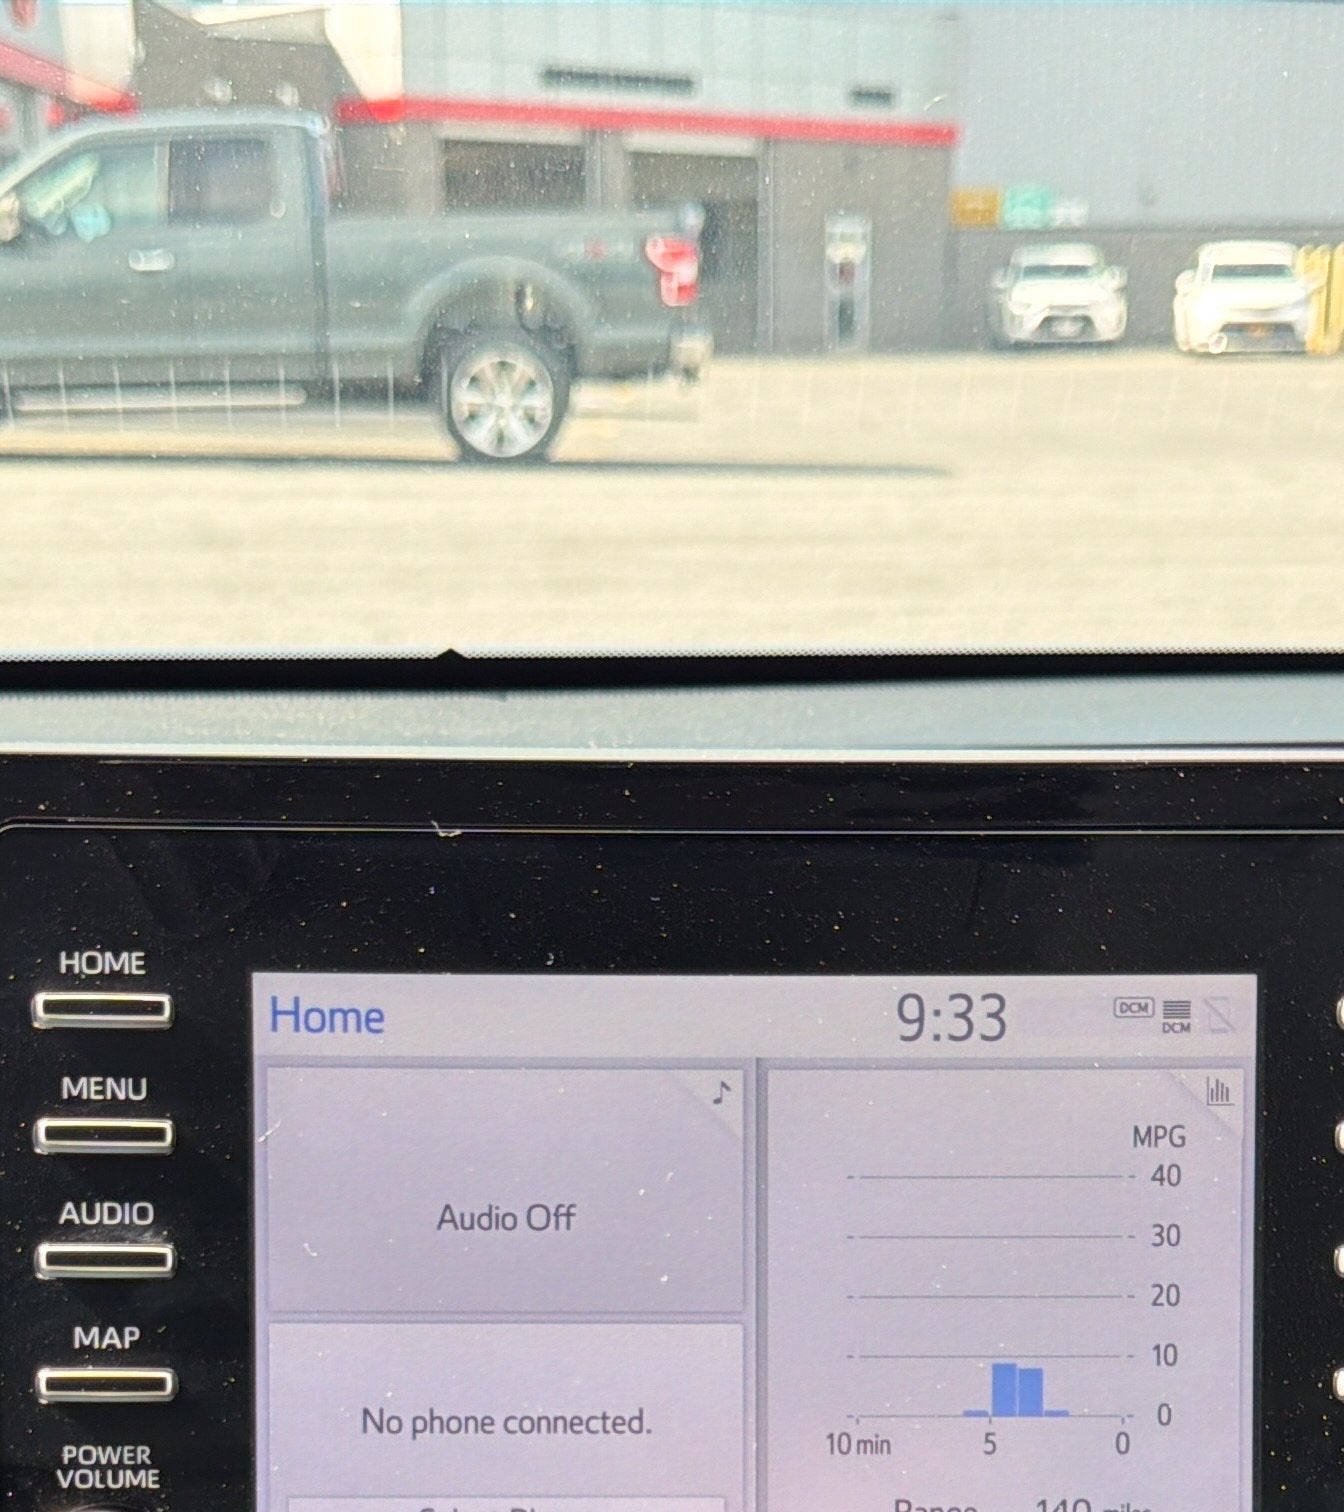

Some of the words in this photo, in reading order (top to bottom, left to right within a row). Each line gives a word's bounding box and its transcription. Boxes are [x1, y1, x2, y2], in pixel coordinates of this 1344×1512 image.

[59, 950, 147, 976] HOME
[269, 995, 386, 1036] Home
[896, 992, 1008, 1043] 9:33
[1119, 1002, 1149, 1014] DCM
[1162, 1022, 1191, 1034] DCM
[61, 1076, 149, 1102] MENU
[1132, 1123, 1187, 1149] MPG
[1149, 1163, 1183, 1188] 40
[58, 1201, 155, 1227] AUDIO
[436, 1201, 519, 1233] Audio
[526, 1202, 578, 1233] Off
[1150, 1223, 1182, 1248] 30
[1150, 1283, 1182, 1308] 20
[73, 1325, 142, 1351] MAP
[1151, 1343, 1179, 1368] 10
[361, 1408, 404, 1435] No
[411, 1408, 495, 1442] phone
[503, 1408, 652, 1435] connected.
[1156, 1403, 1173, 1428] 0
[62, 1445, 152, 1466] POWER
[826, 1432, 854, 1457] 10
[858, 1432, 892, 1457] min
[983, 1433, 997, 1457] 5
[1114, 1432, 1131, 1457] 0
[57, 1468, 161, 1489] VOLUME
